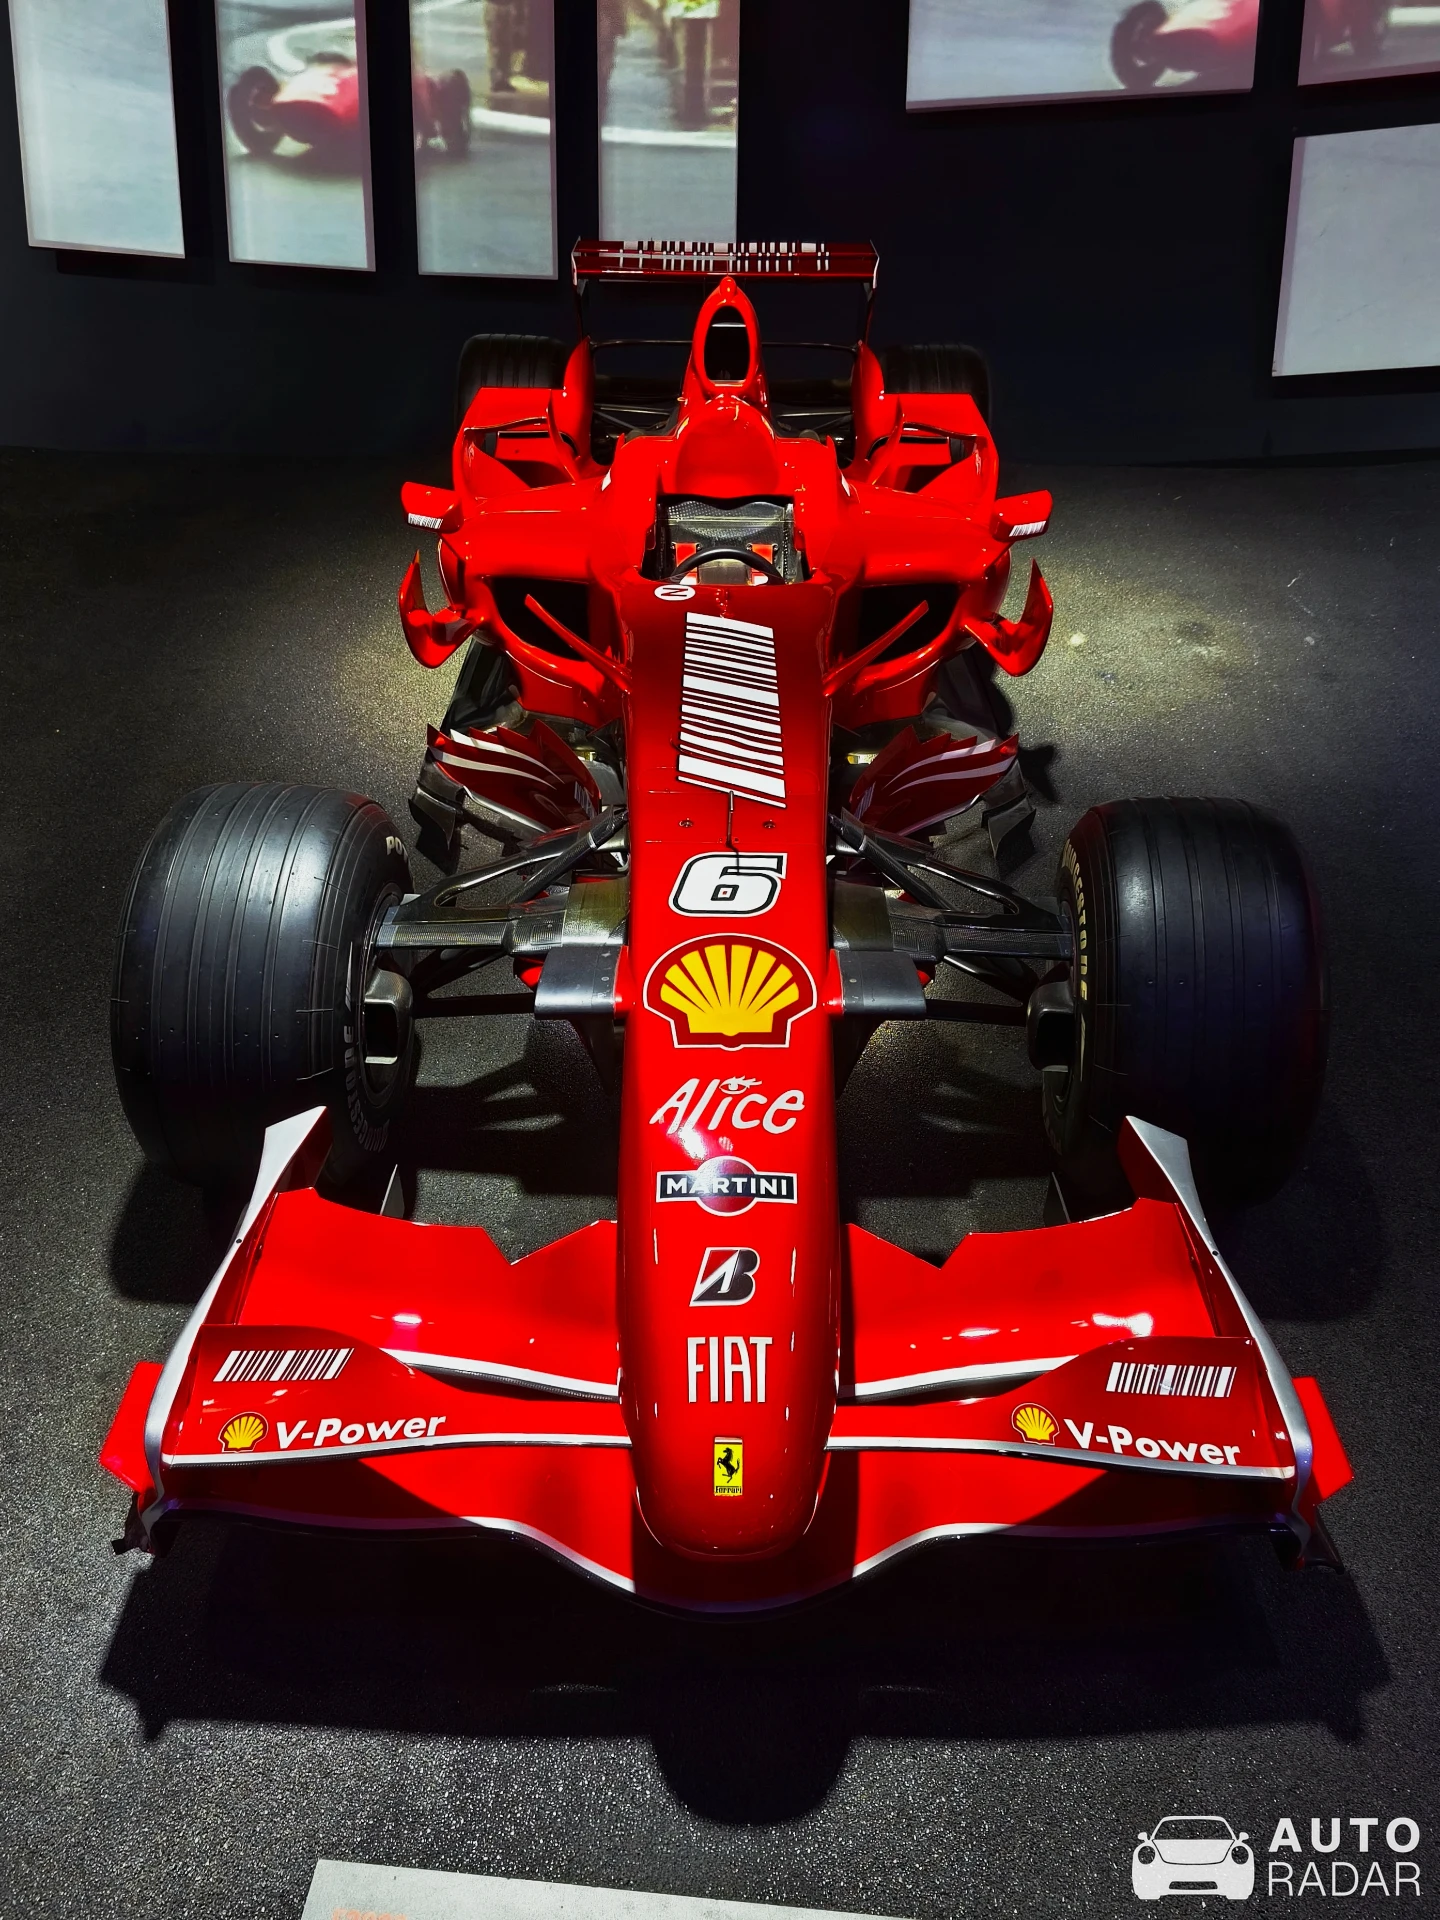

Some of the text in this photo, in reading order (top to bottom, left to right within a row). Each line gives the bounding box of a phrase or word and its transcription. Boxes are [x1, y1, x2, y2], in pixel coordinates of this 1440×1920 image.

[668, 852, 788, 918] 6
[649, 1076, 805, 1135] Alice
[666, 1177, 787, 1196] MARTINI
[687, 1336, 774, 1404] FIAT
[276, 1415, 447, 1449] V-Power
[1063, 1418, 1240, 1465] V-Power
[715, 1485, 742, 1494] Ferrari
